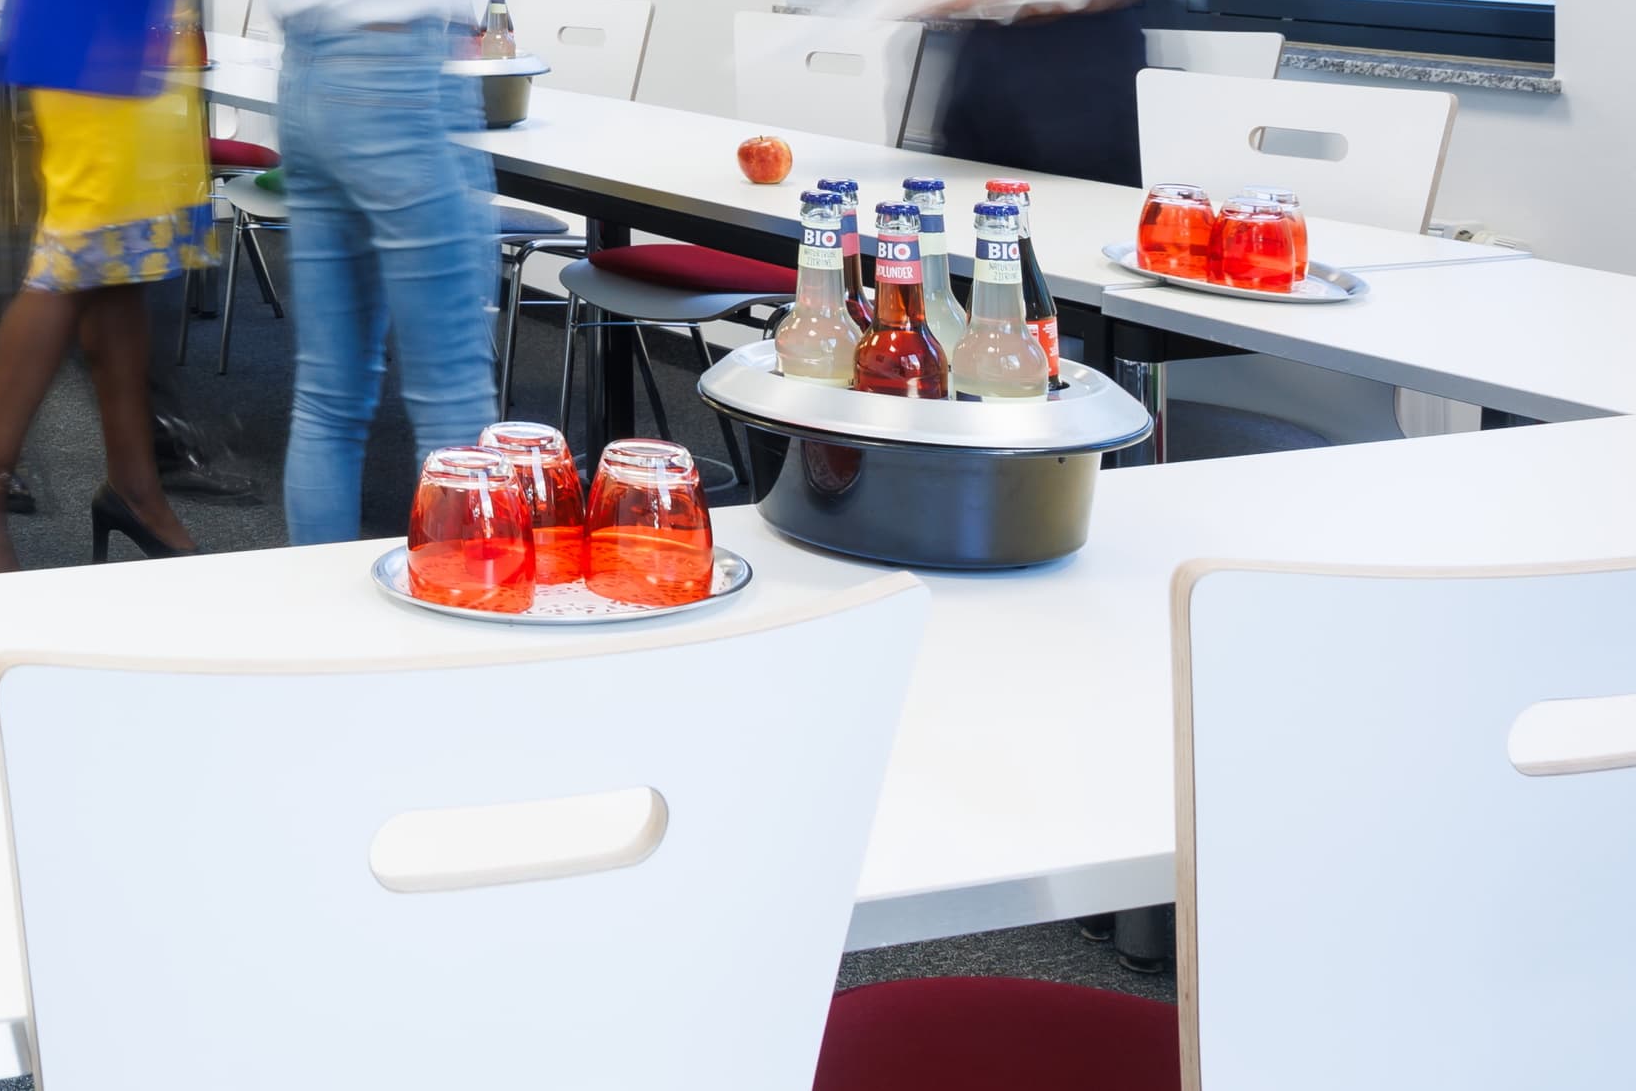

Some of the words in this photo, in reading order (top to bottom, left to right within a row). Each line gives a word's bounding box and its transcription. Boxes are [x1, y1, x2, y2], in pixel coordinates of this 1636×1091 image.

[805, 229, 837, 247] BIO
[878, 241, 912, 260] BIO
[989, 243, 1019, 259] BIO
